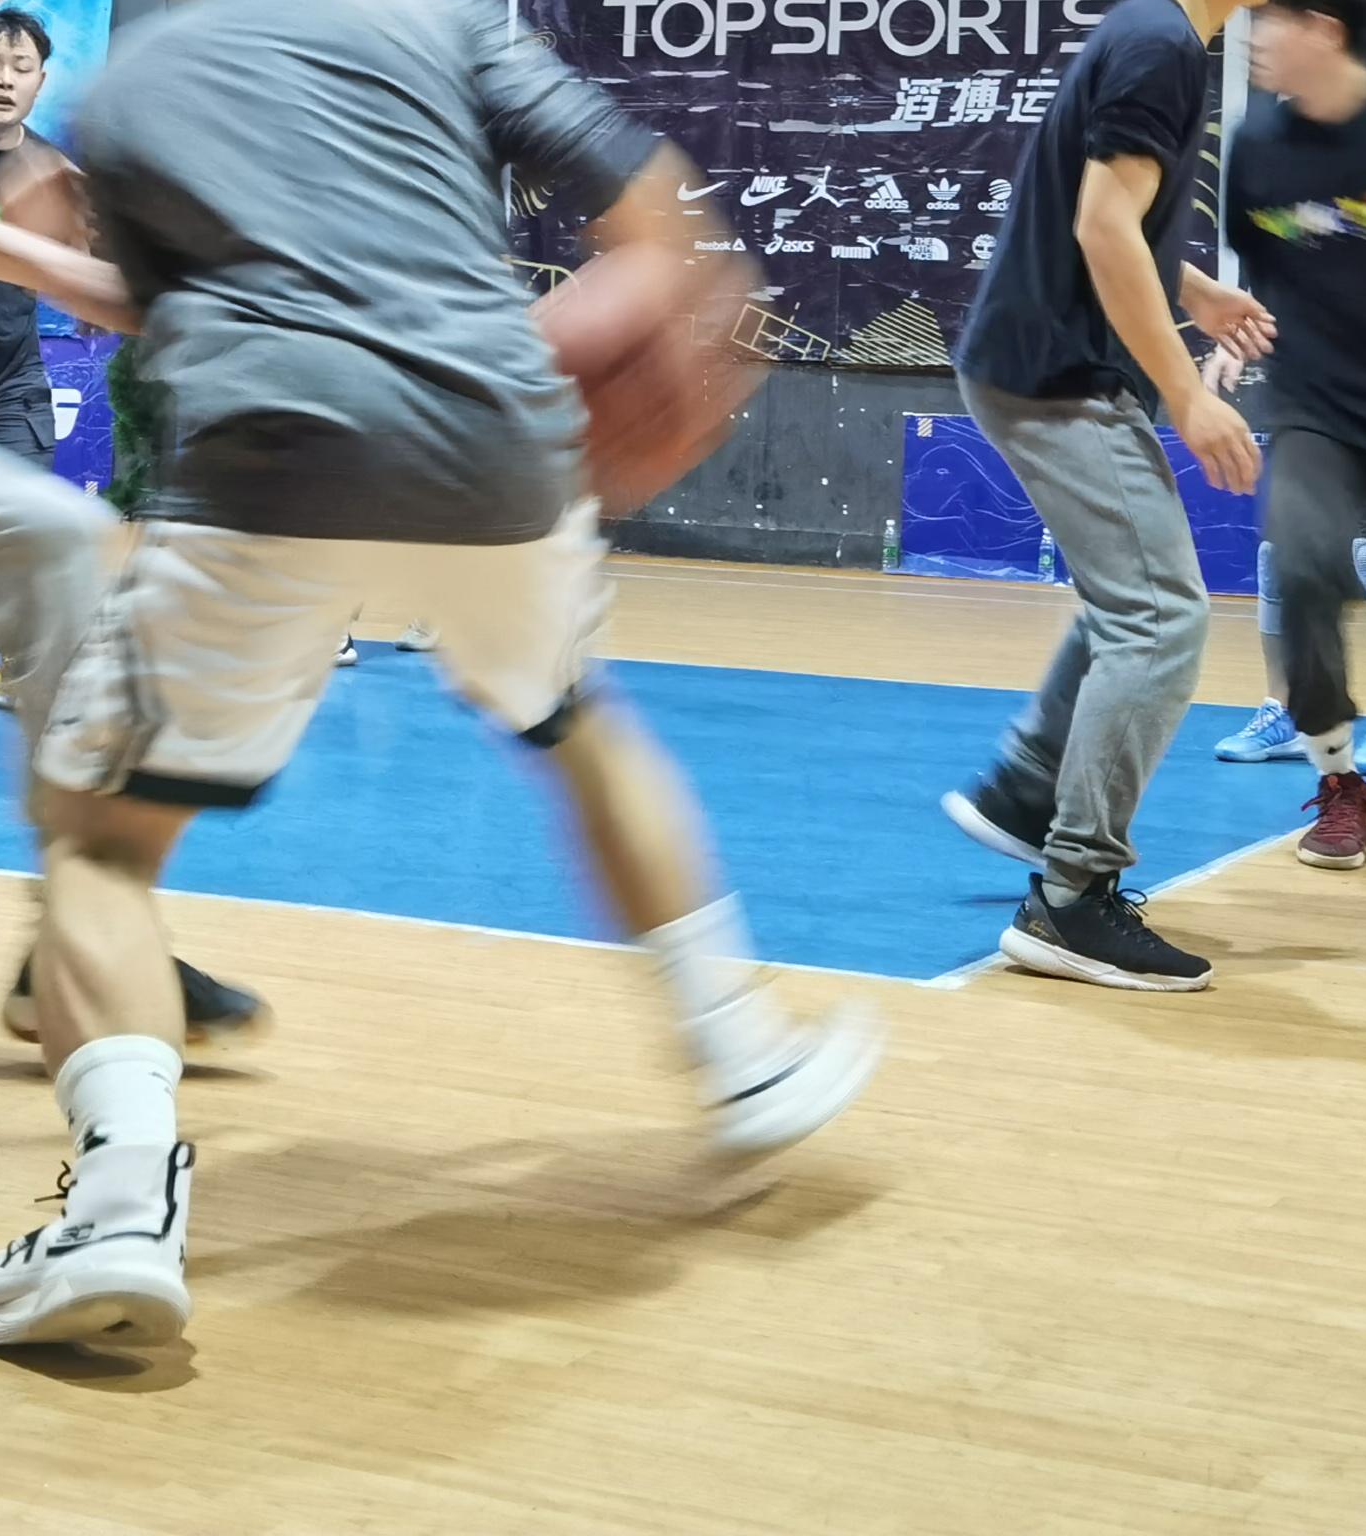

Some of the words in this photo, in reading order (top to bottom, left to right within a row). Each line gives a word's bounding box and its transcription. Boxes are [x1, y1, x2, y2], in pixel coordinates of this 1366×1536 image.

[750, 175, 788, 193] NIKE
[864, 199, 910, 210] adidas
[926, 201, 961, 211] adidas
[977, 200, 1008, 211] adid
[694, 240, 731, 251] Reebok
